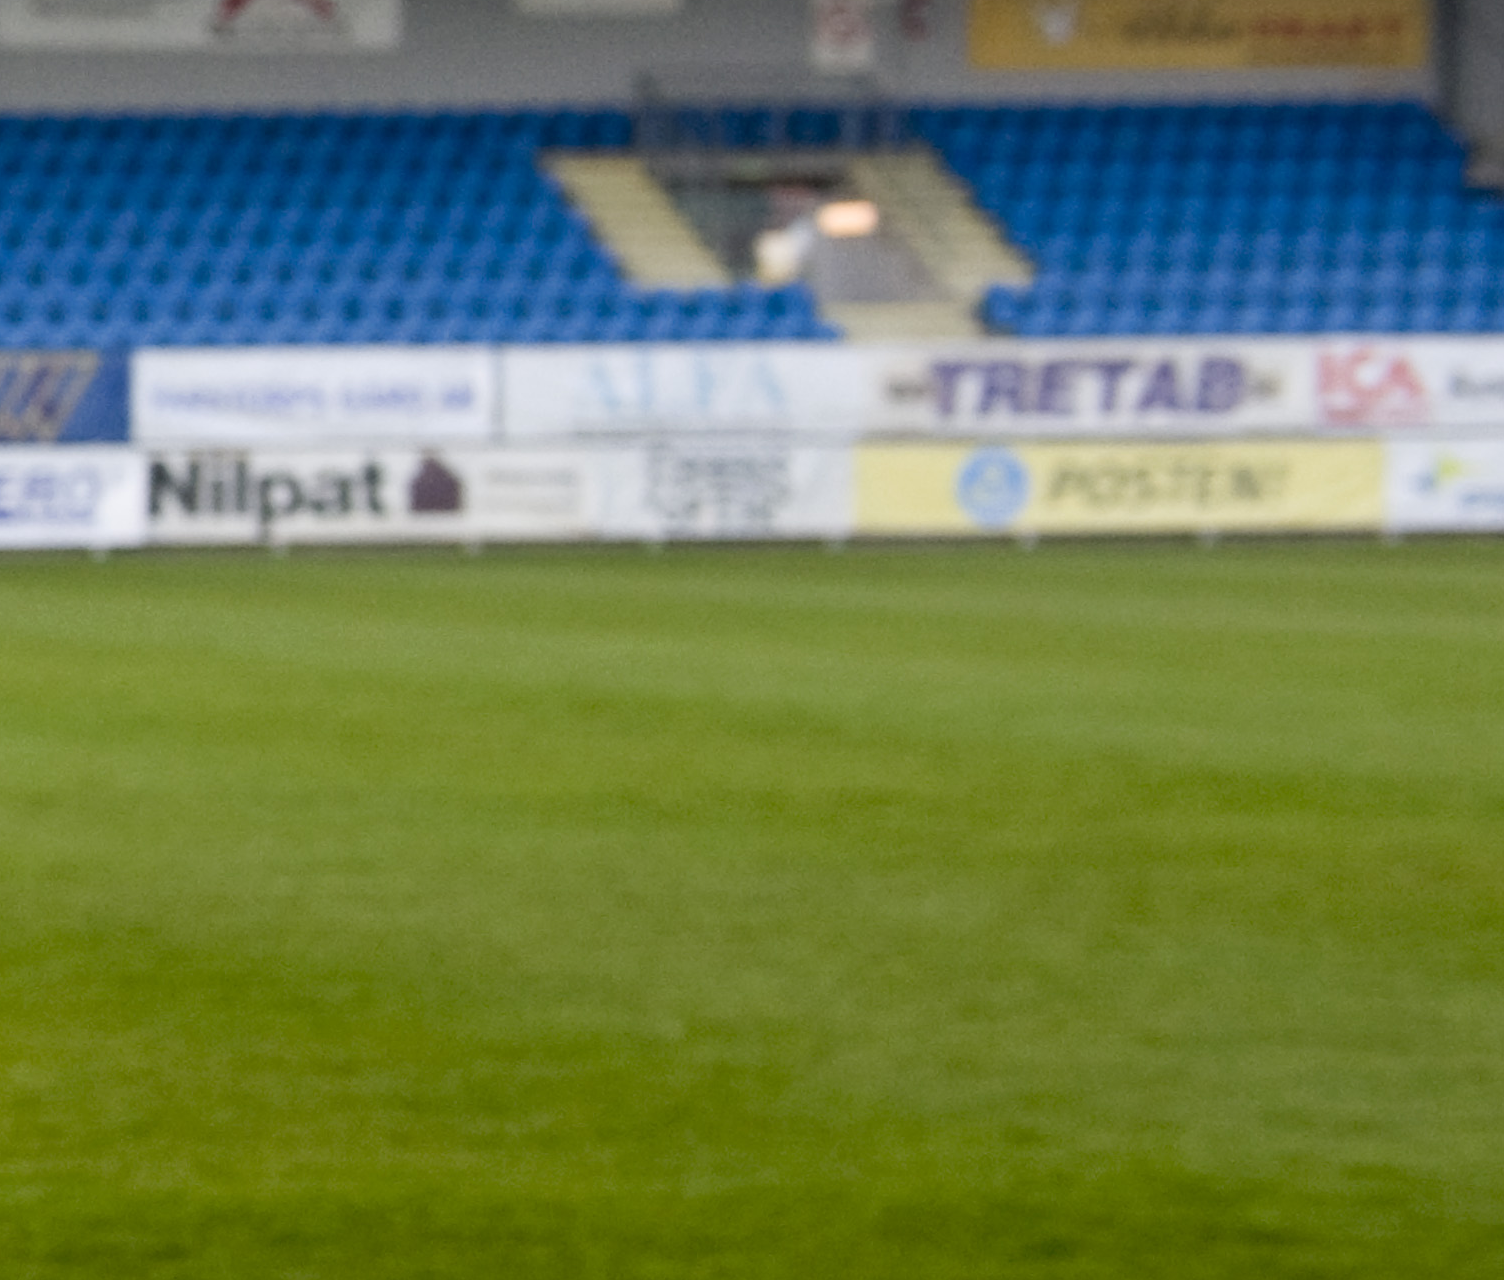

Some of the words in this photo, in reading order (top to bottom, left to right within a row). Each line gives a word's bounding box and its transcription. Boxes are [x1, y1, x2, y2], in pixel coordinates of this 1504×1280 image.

[929, 357, 1256, 418] TRETAB
[1314, 347, 1428, 405] ICA
[148, 451, 387, 533] Nilpat
